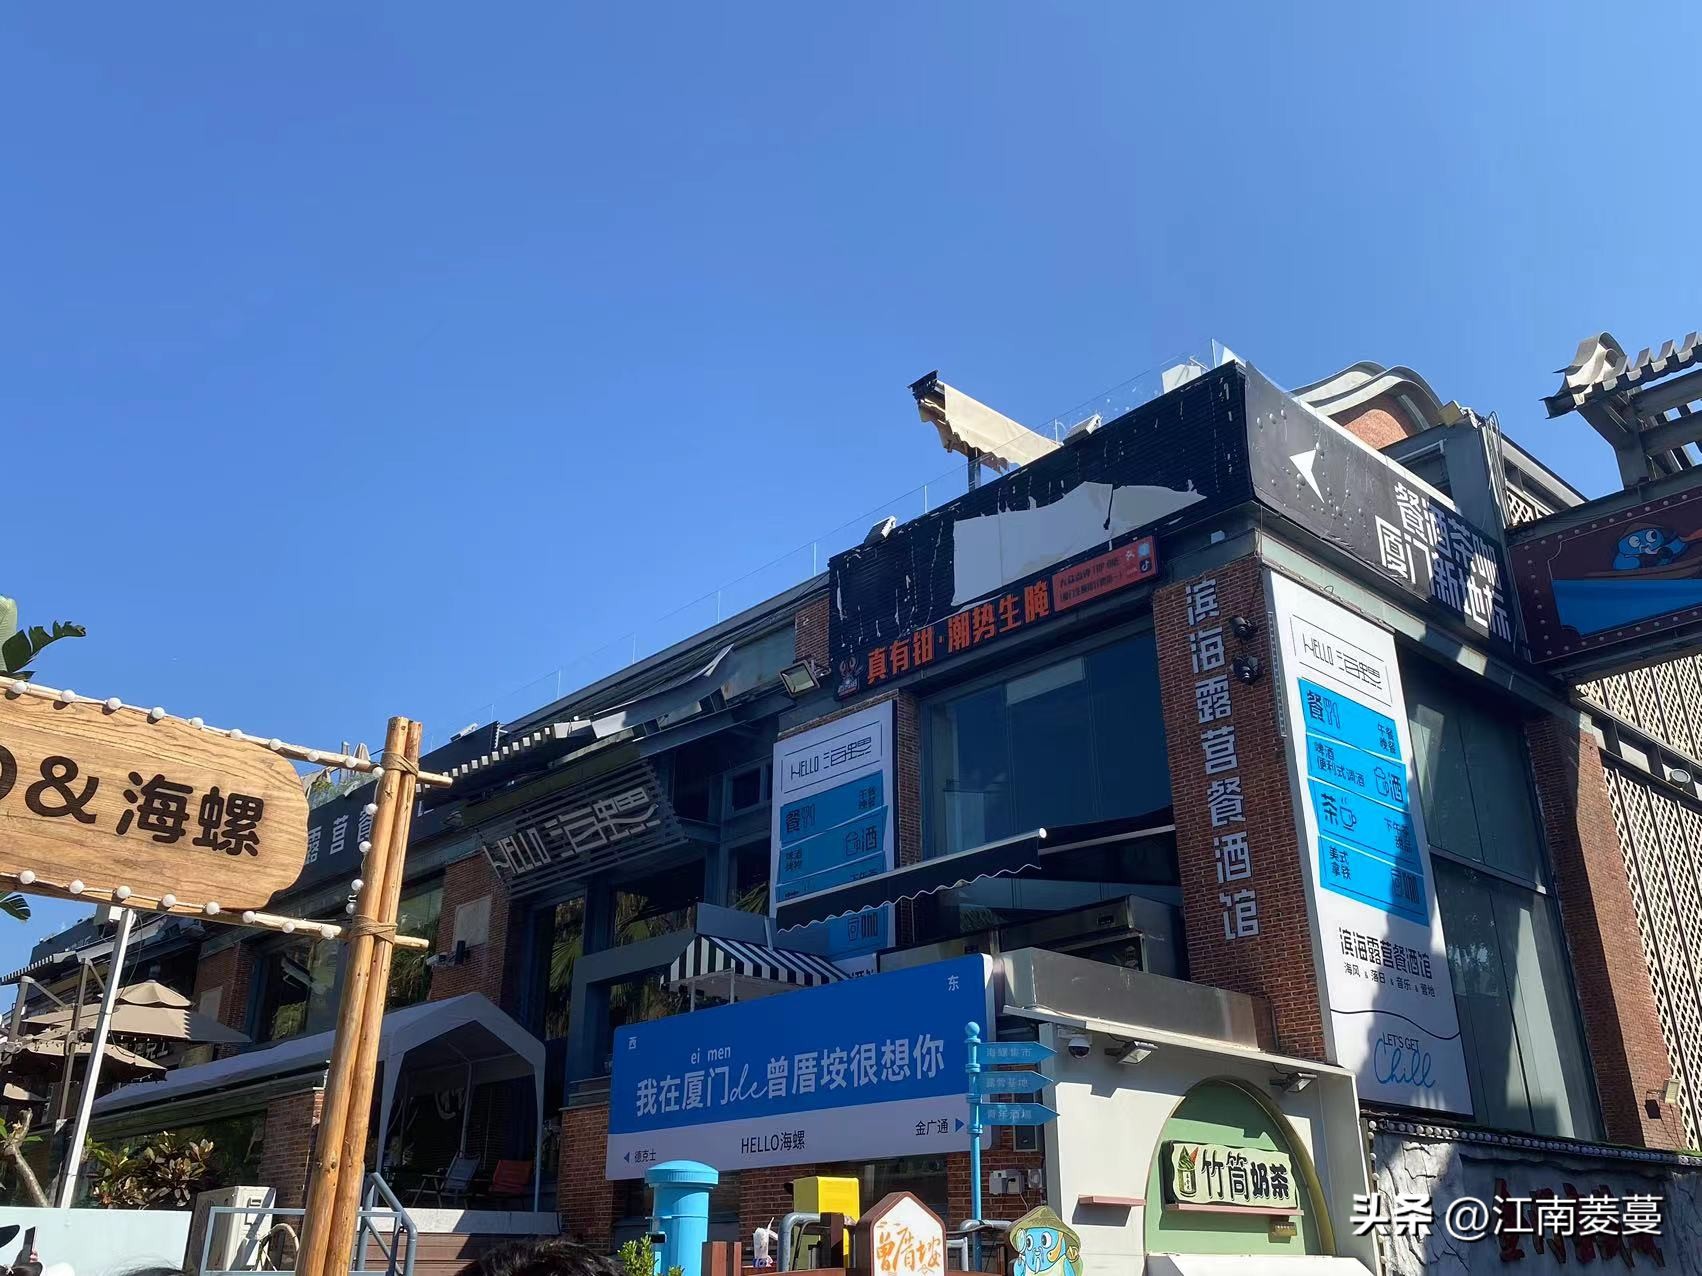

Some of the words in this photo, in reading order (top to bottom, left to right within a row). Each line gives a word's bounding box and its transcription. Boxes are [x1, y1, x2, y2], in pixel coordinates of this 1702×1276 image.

[1374, 514, 1512, 643] 厦门新地标
[1302, 633, 1334, 666] HELLO
[1306, 690, 1326, 723] 餐
[790, 755, 819, 781] HELLO
[1185, 577, 1261, 941] 滨海露营餐酒馆
[1387, 772, 1404, 802] 酒
[116, 770, 265, 858] 海螺
[1320, 791, 1338, 826] 茶
[1329, 845, 1350, 867] 美式
[1338, 926, 1434, 980] 滨海露营餐酒馆
[946, 973, 961, 993] 东
[1396, 976, 1412, 992] 音乐
[627, 1036, 639, 1052] 西
[690, 1047, 701, 1065] ei
[707, 1045, 732, 1063] men
[1382, 1031, 1404, 1049] LET'S
[1404, 1035, 1420, 1052] GET
[1373, 1037, 1436, 1089] Chill
[914, 1117, 950, 1138] 金广通
[633, 1148, 658, 1164] 德克士
[1200, 1148, 1291, 1201] 竹筒奶茶
